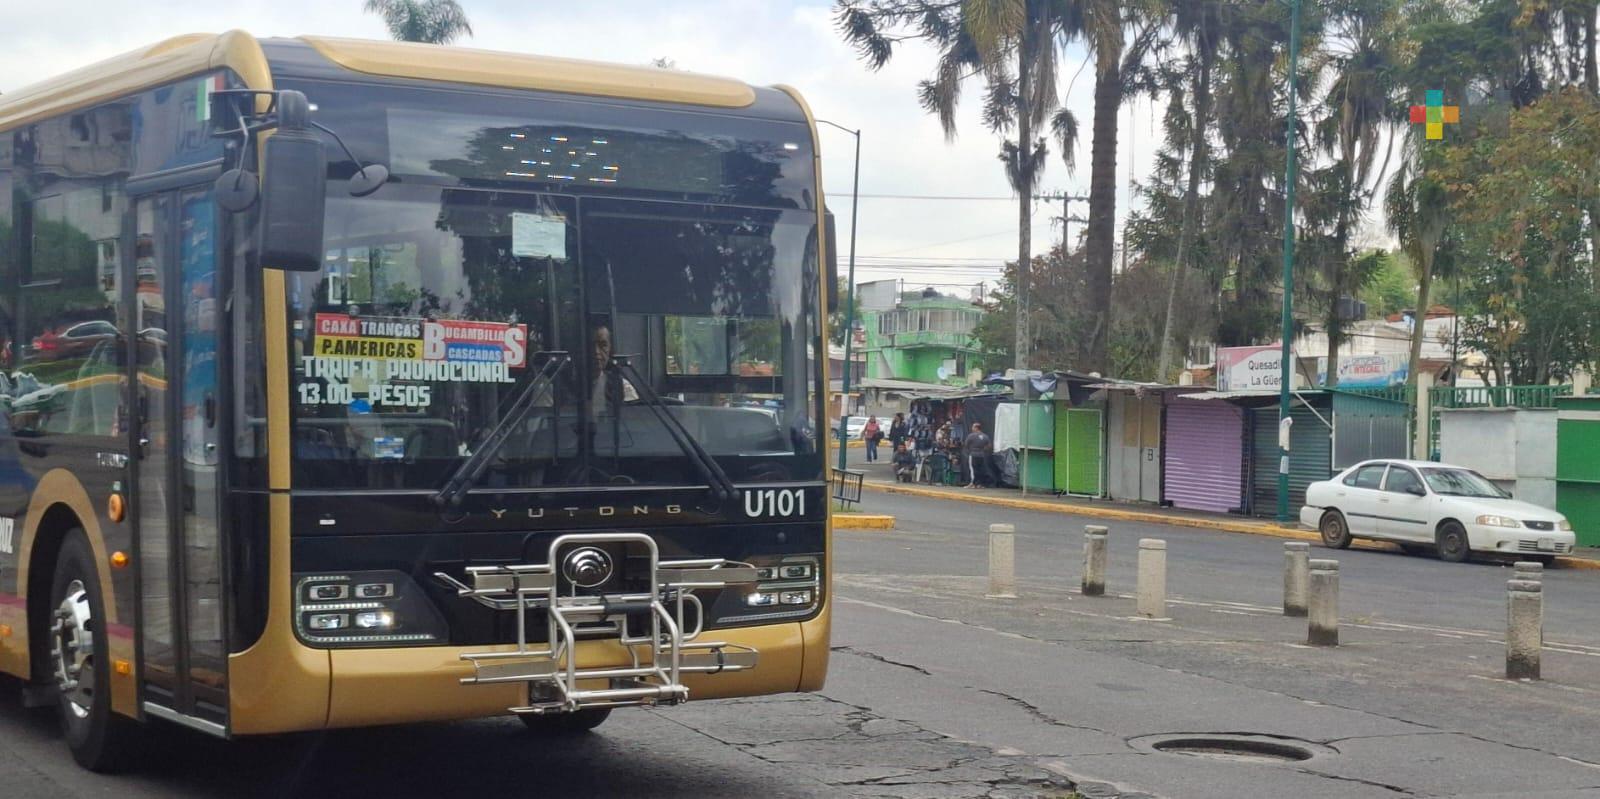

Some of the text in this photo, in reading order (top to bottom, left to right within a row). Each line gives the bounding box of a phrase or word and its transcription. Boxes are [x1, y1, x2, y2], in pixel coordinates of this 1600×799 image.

[321, 319, 420, 338] CAXA TRANCAS
[321, 338, 416, 359] P.AMERICAS
[448, 347, 502, 362] CASCADAS
[302, 355, 516, 384] TARIFA PROMOCIONAL
[1248, 359, 1283, 371] Quesadi
[1251, 375, 1262, 386] La
[1263, 374, 1283, 386] Güer
[369, 384, 432, 407] PESOS
[490, 504, 682, 519] YUTONG
[744, 489, 806, 518] U101
